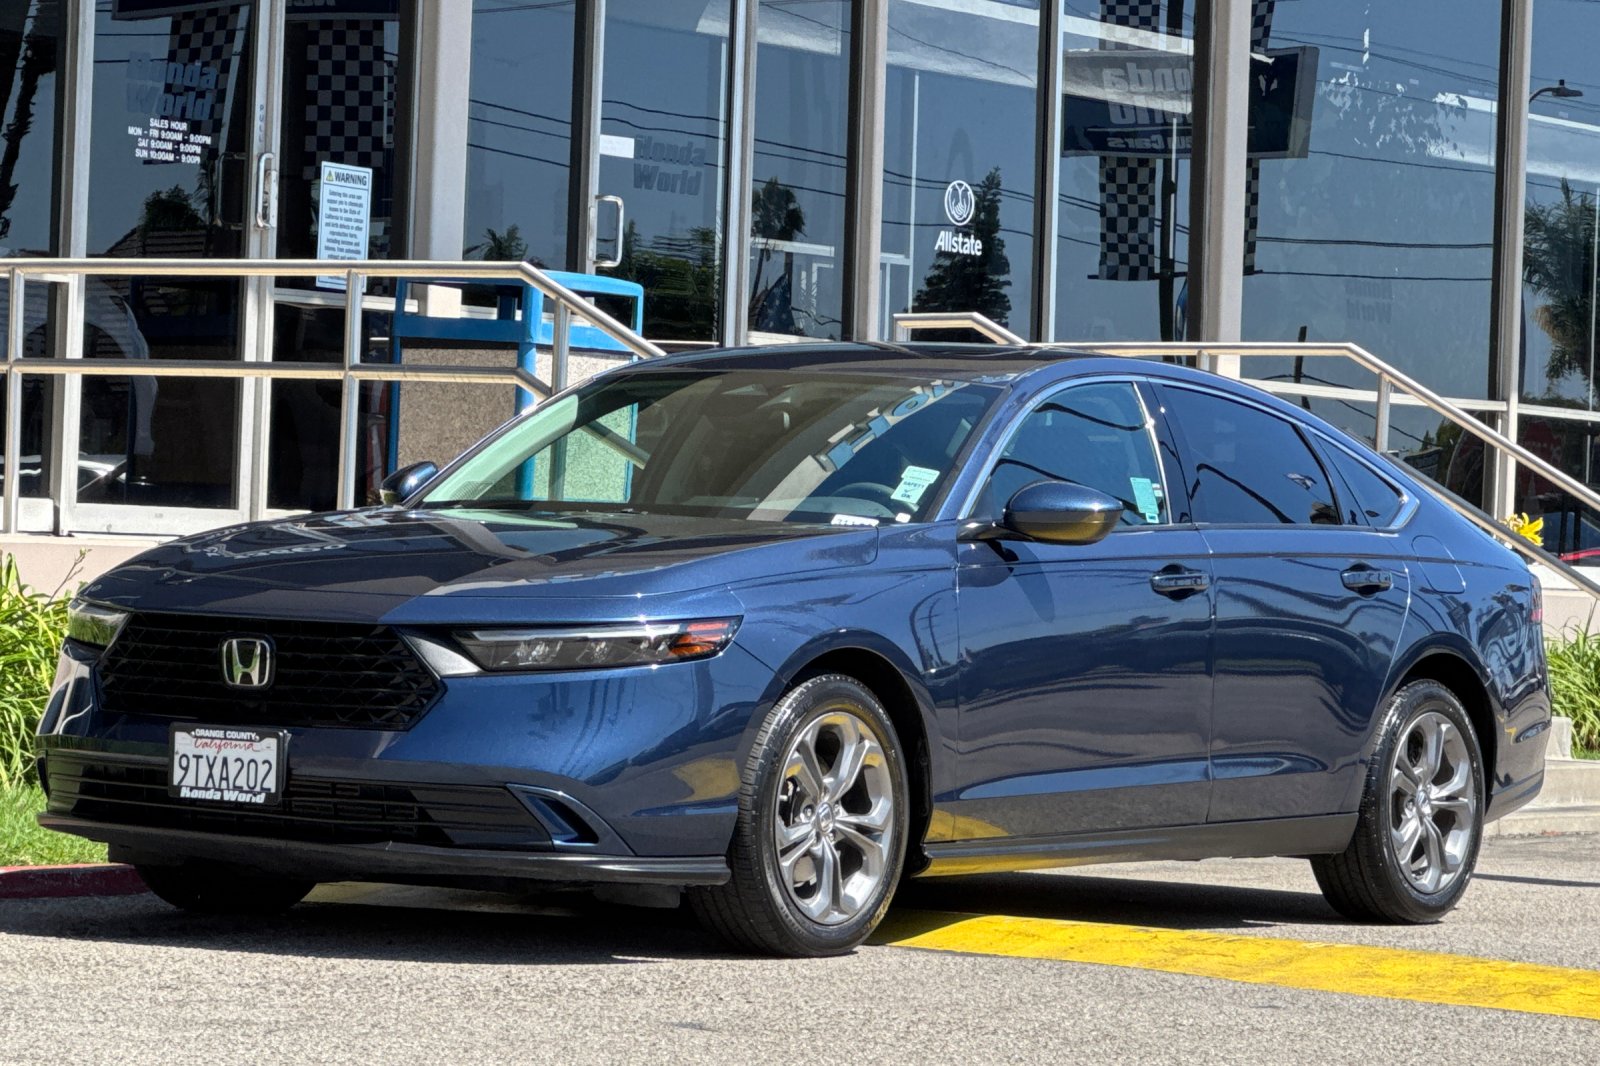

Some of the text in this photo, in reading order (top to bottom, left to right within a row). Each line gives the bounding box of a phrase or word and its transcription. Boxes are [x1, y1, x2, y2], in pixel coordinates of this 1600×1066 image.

[149, 118, 187, 131] SALES HOUR
[127, 126, 143, 136] MON
[149, 129, 160, 138] FRI
[160, 131, 183, 141] 9:00AM
[189, 134, 212, 145] 9:00PM
[135, 148, 148, 158] SUN
[150, 151, 175, 161] 10:00AM
[150, 140, 173, 151] 9:00AM
[179, 143, 202, 154] 9:00PM
[633, 134, 706, 167] Honda
[334, 171, 367, 186] WARNING
[633, 163, 703, 196] World
[934, 230, 983, 256] Allstate
[195, 729, 256, 740] ORANGE COUNTY
[194, 738, 262, 753] California
[178, 753, 273, 792] 9TXA202
[180, 787, 267, 804] Honda World
